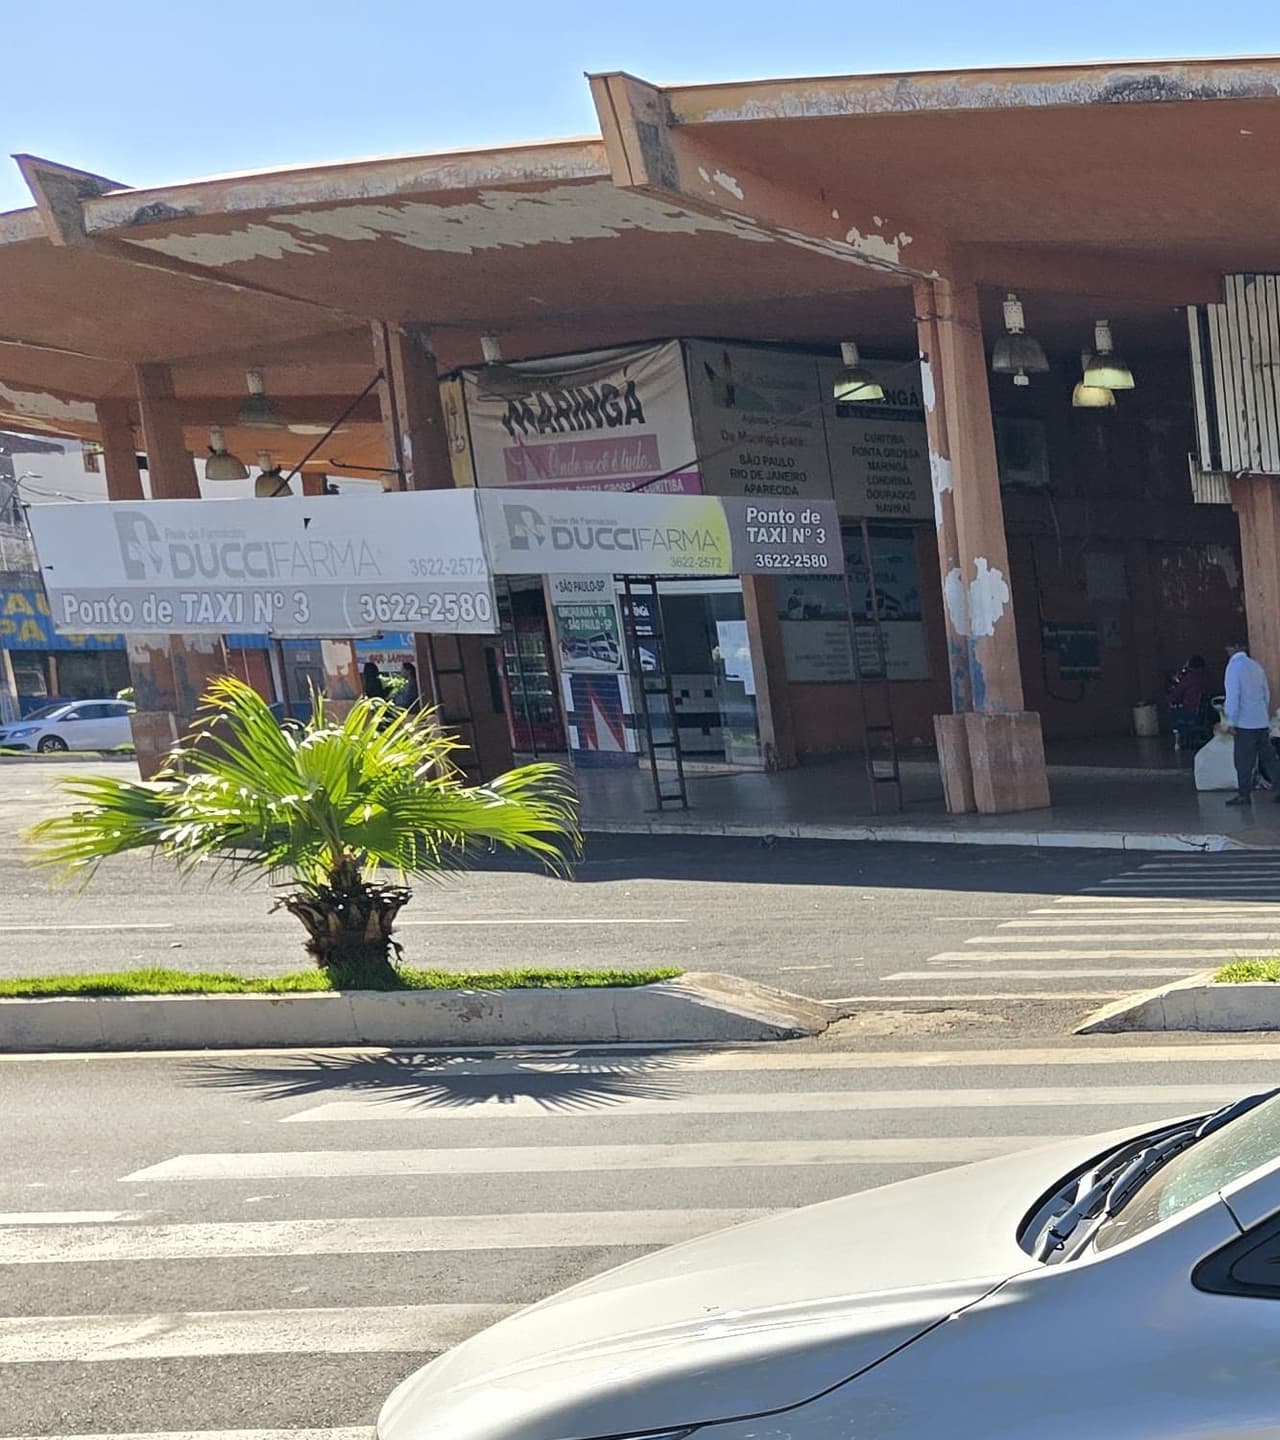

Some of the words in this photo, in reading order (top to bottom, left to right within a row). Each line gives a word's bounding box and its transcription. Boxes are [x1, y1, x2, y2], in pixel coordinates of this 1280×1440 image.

[739, 453, 762, 467] SÃO
[763, 454, 795, 467] PAULO
[730, 469, 748, 481] RIO
[749, 470, 764, 481] DE
[766, 470, 807, 482] JANEIRO
[744, 483, 799, 496] APARECIDA
[746, 507, 796, 525] Ponto
[801, 507, 821, 525] de
[552, 527, 719, 551] DUCCIFARMA
[746, 527, 787, 544] TAXI
[816, 527, 827, 544] 3
[168, 539, 383, 579] DUCCIFARMA
[409, 557, 485, 577] 3622-2572
[670, 556, 722, 569] 3622-2572
[756, 554, 828, 569] 3622-2580
[61, 593, 134, 624] Ponto
[143, 592, 172, 624] de
[180, 591, 244, 623] TAXI
[293, 590, 311, 623] 3
[360, 592, 492, 623] 3622-2580
